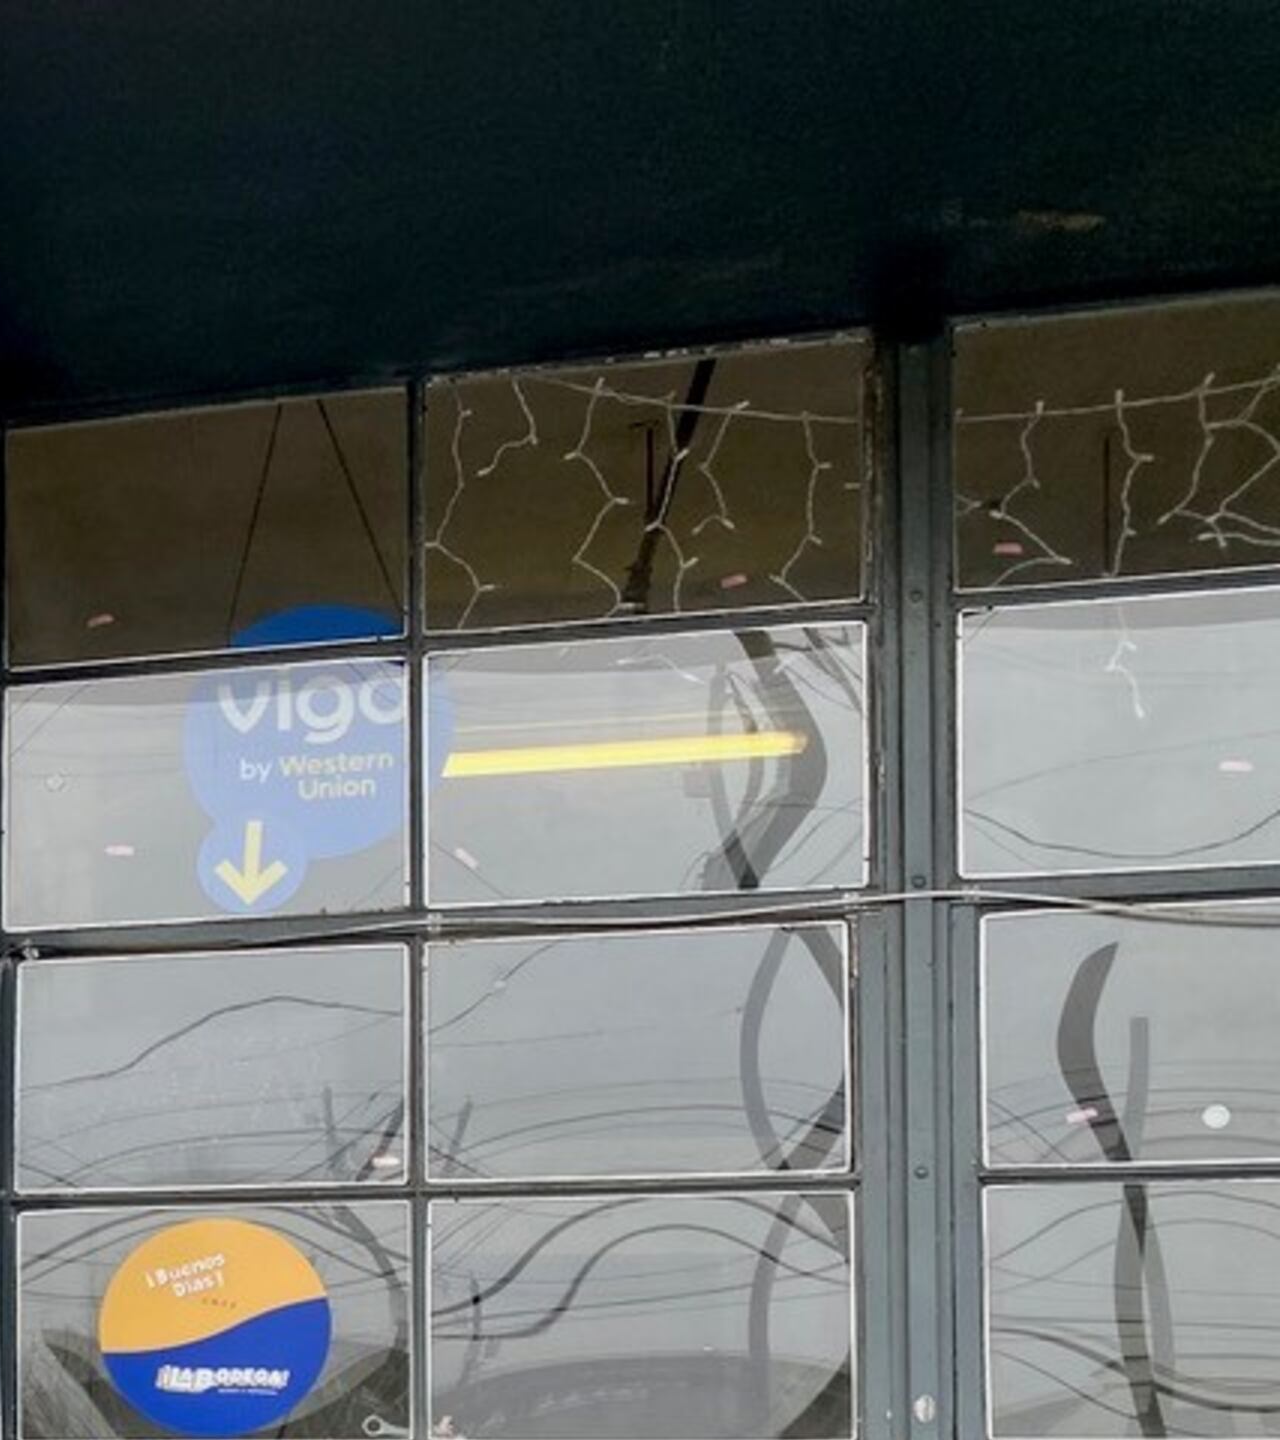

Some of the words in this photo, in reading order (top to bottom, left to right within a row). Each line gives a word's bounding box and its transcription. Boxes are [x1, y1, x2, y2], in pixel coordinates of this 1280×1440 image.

[239, 759, 272, 784] by
[278, 751, 395, 777] Western
[297, 775, 376, 800] Union
